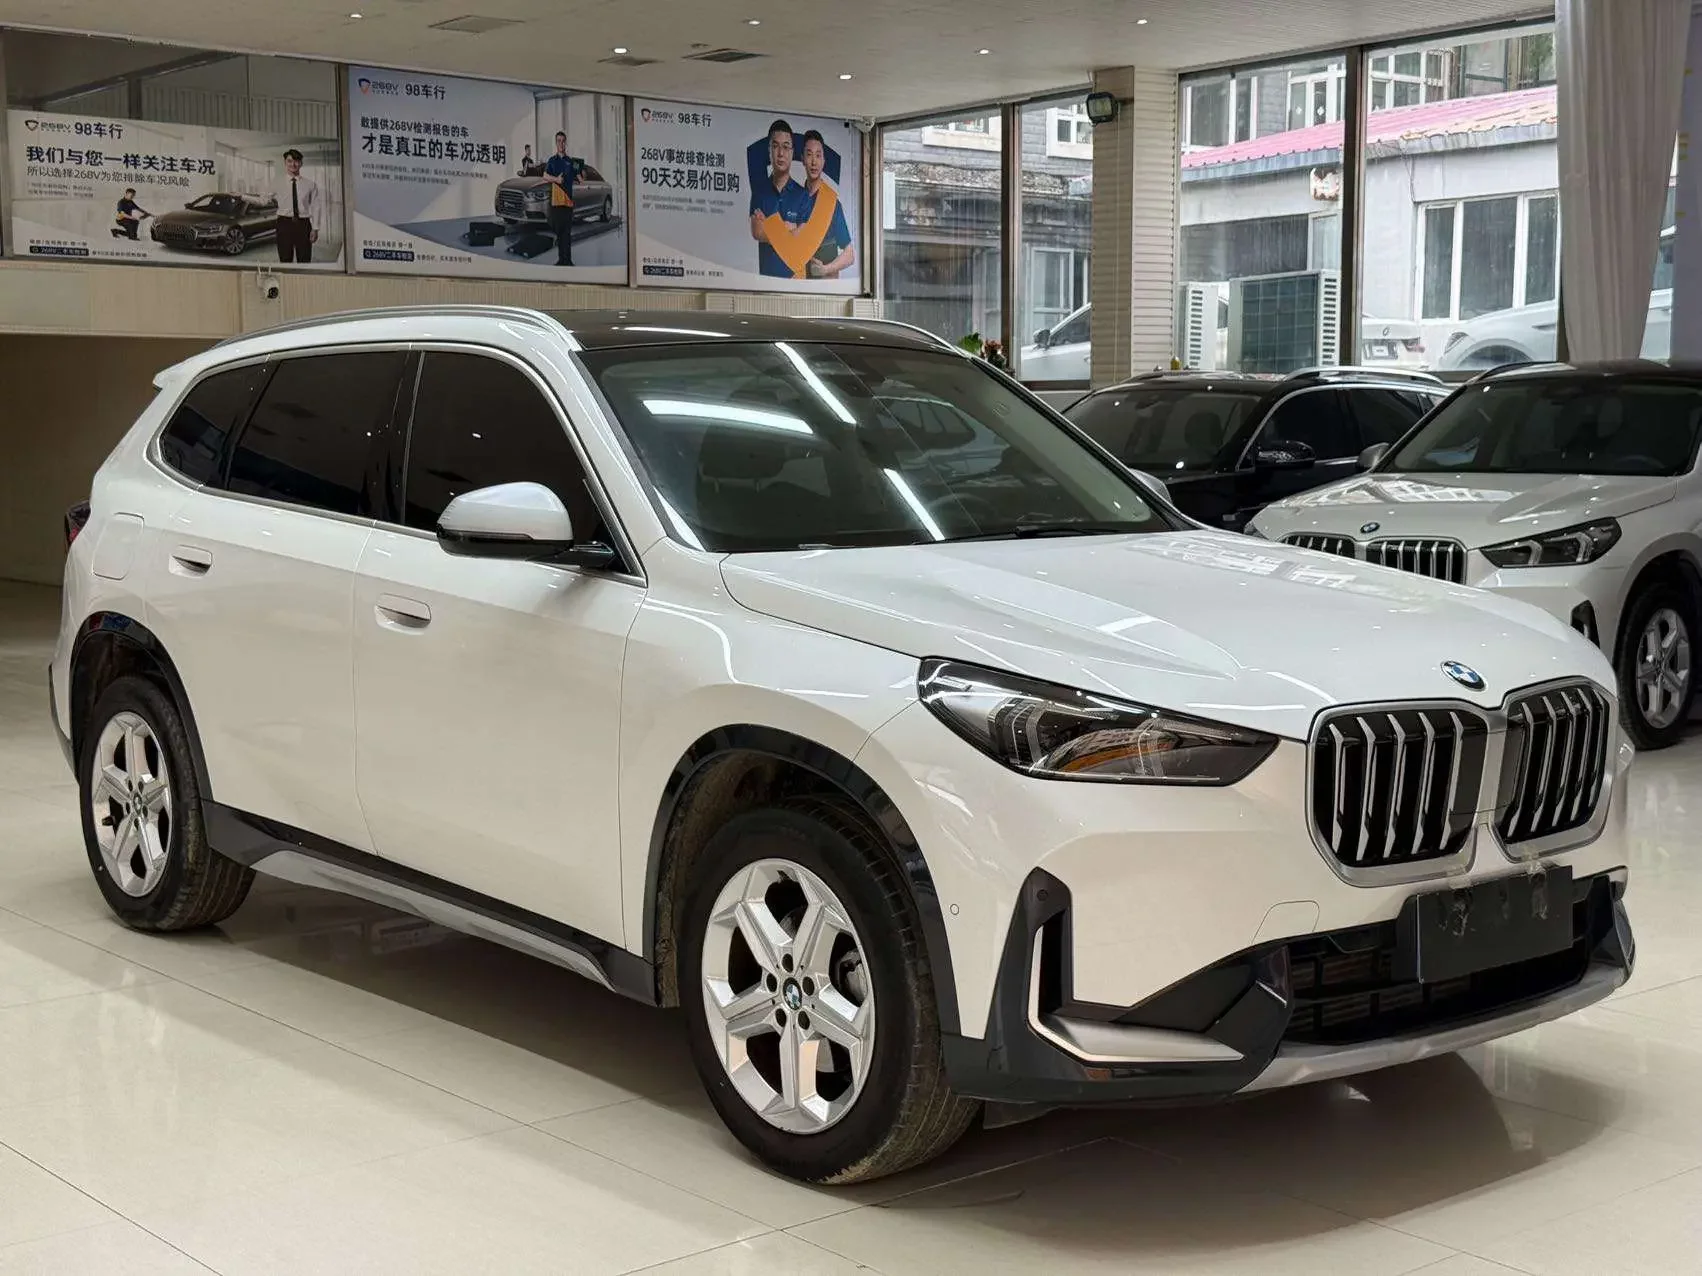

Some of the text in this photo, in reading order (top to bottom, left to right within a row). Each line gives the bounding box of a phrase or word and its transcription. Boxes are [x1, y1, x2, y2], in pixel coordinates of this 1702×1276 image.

[405, 83, 446, 100] 98车行
[74, 121, 124, 139] 98车行
[360, 116, 469, 138] 敢提供268V检测报告的车
[678, 112, 711, 127] 98车行
[361, 133, 507, 165] 才是真正的车况透明
[641, 147, 725, 168] 268V事故排查检测
[26, 146, 216, 175] 我们与您一样关注车况
[26, 166, 190, 187] 所以选择268V为您排除车况风险
[641, 167, 740, 193] 90天交易价回购
